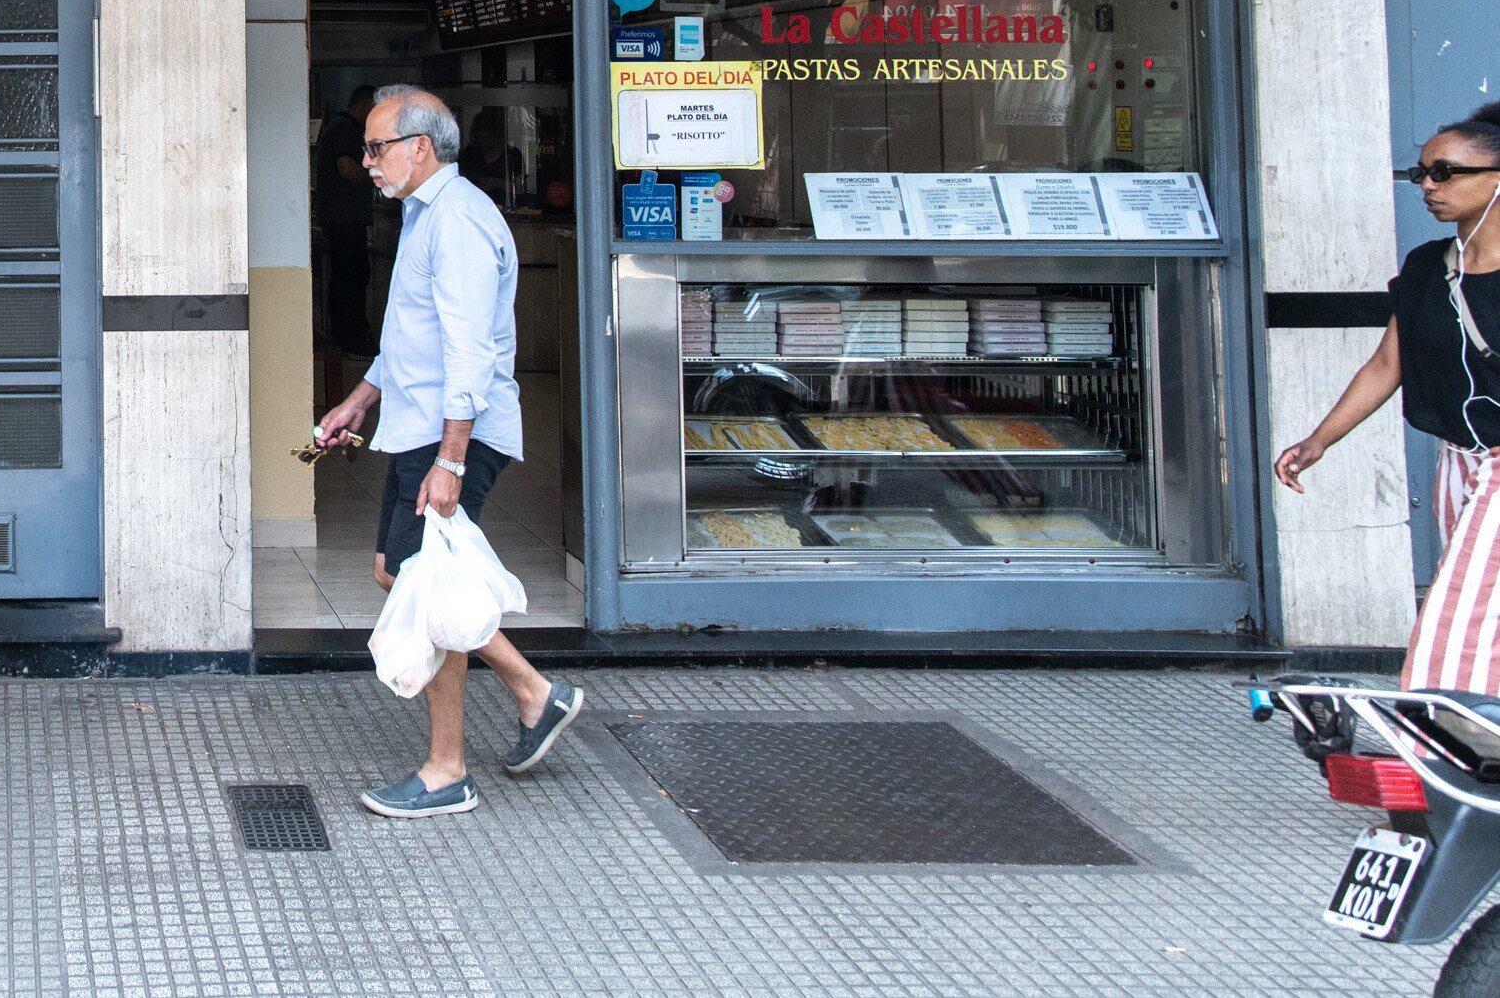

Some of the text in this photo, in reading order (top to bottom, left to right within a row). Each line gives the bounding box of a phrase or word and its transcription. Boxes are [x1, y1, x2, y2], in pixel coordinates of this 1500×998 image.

[760, 5, 813, 45] La
[829, 4, 1067, 45] Castellana
[620, 30, 656, 38] Preferimos
[621, 44, 641, 52] VISA
[762, 58, 1069, 81] PASTAS ARTESANALES
[620, 70, 754, 86] PLATO DEL DIA
[713, 112, 728, 120] DÍA
[626, 206, 673, 222] VISA
[1354, 850, 1400, 888] 641
[1338, 882, 1387, 923] KOX
